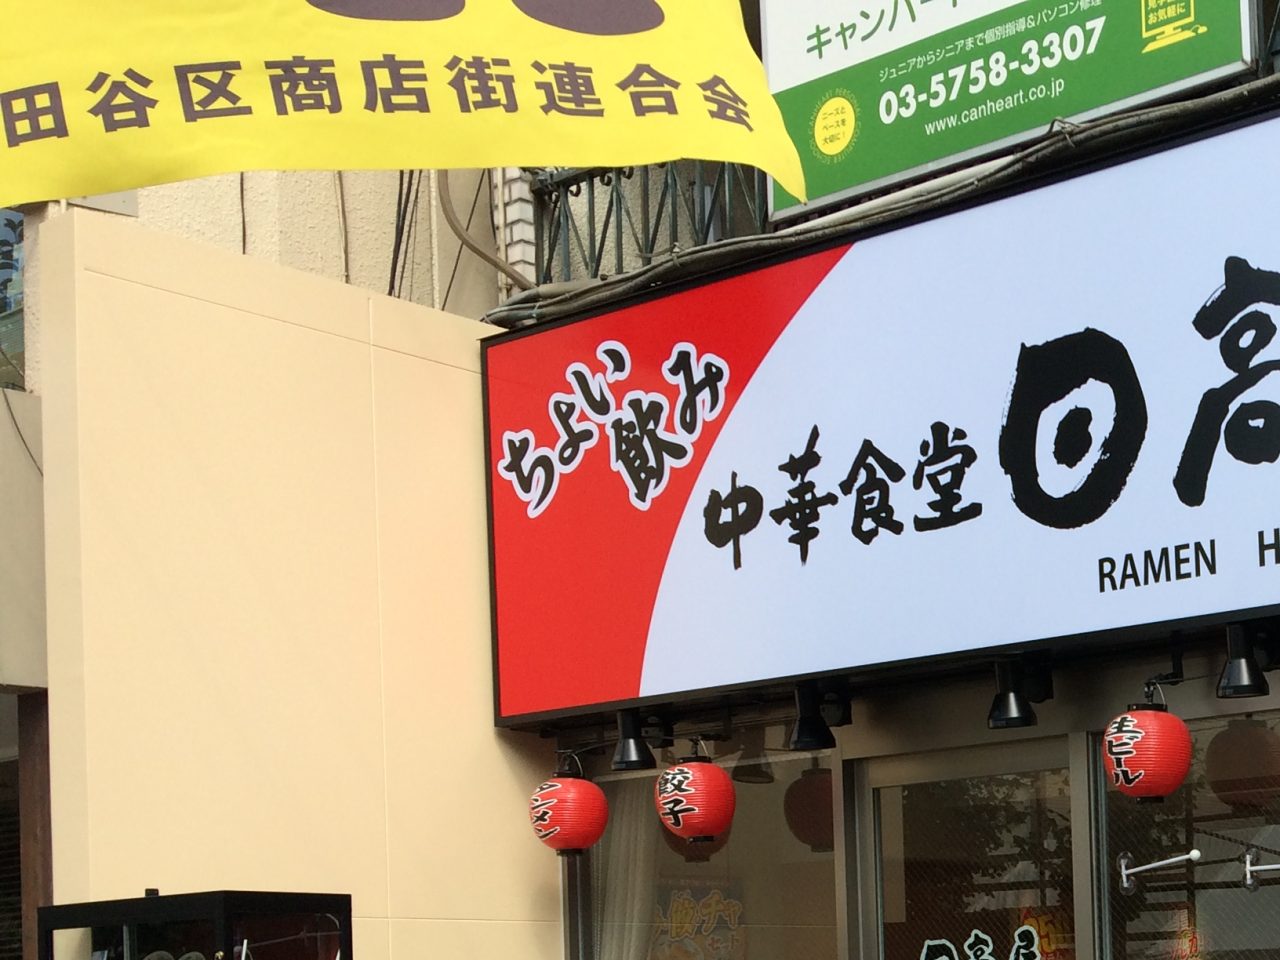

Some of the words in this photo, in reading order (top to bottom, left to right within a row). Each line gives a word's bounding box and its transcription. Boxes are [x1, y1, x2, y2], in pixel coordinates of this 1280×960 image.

[806, 0, 957, 59] キャンハ
[1, 53, 756, 149] 田谷区商店街連合会
[879, 16, 1107, 124] 03-5758-3307
[924, 77, 1065, 136] www.canheart.co.jp
[703, 422, 983, 571] 中華食堂
[1099, 539, 1218, 593] RAMEN
[1104, 715, 1146, 787] 生ビール
[658, 767, 698, 829] 餃子
